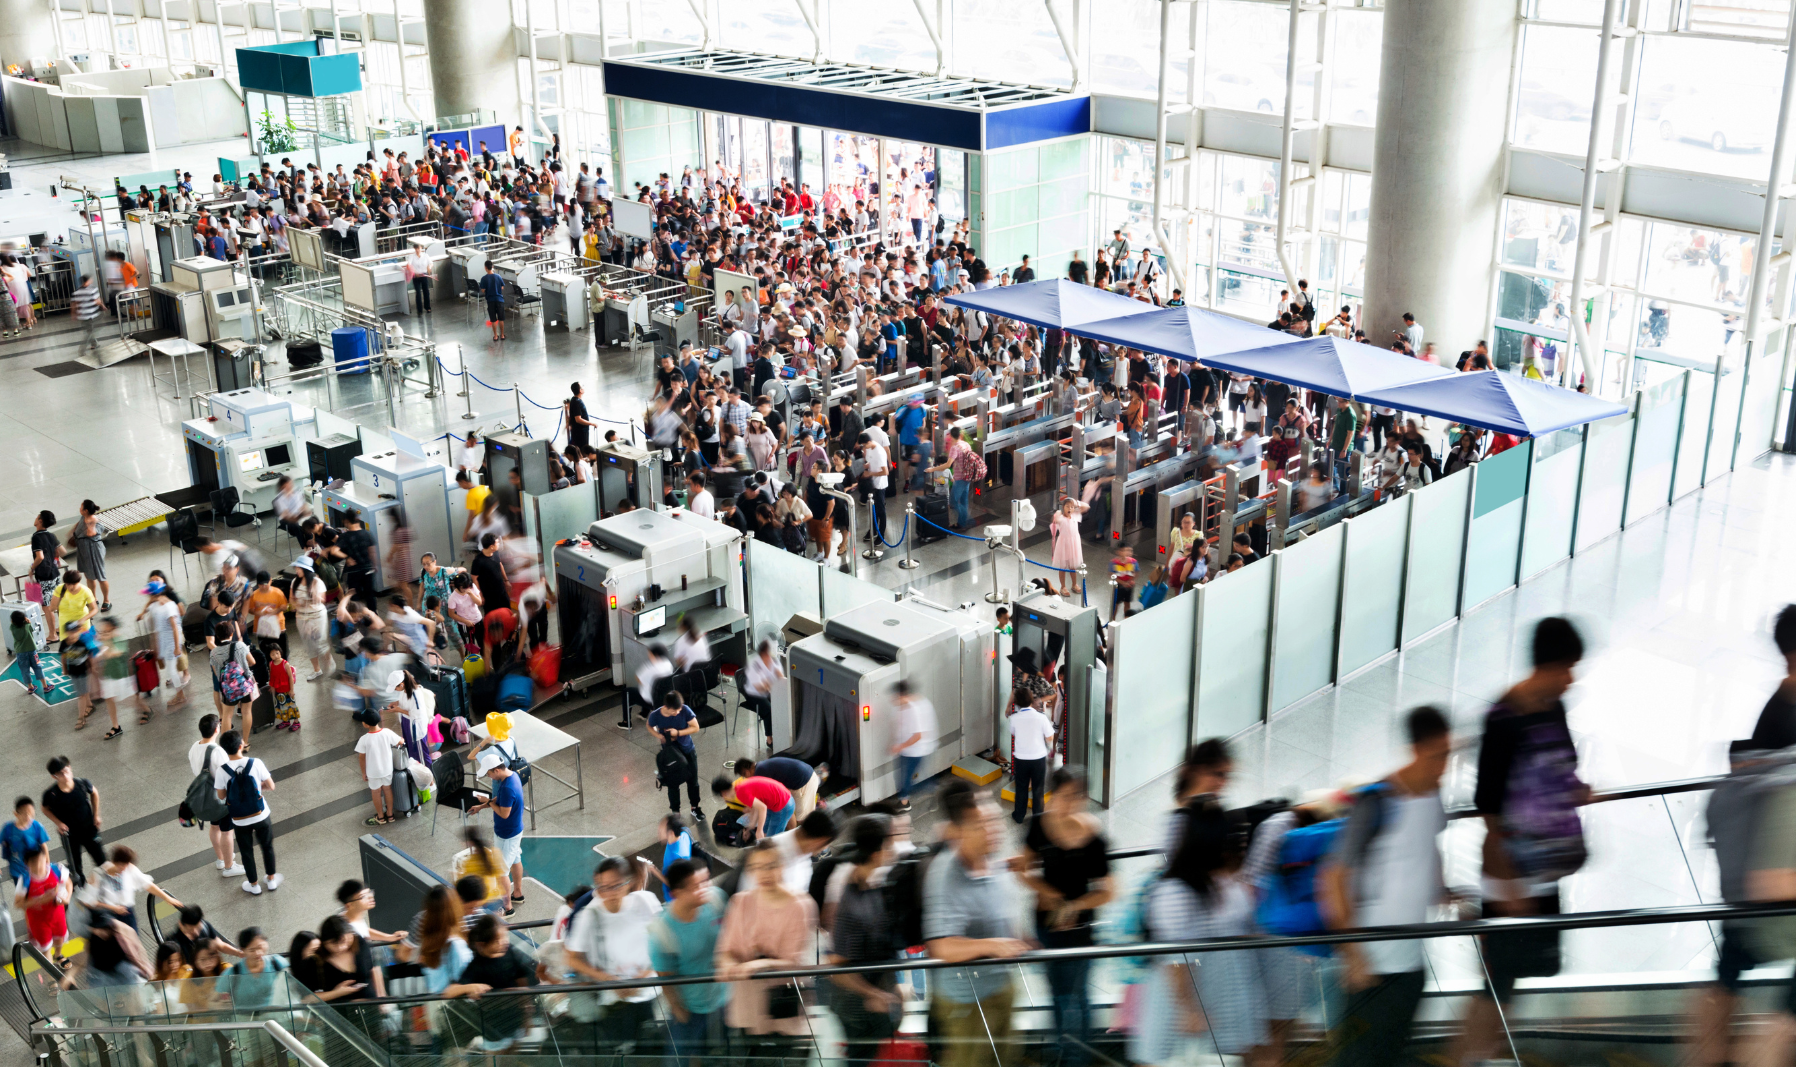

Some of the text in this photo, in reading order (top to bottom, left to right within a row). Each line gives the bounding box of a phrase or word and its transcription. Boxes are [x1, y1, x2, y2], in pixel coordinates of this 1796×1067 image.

[227, 409, 232, 421] 4
[372, 473, 380, 488] 3
[577, 565, 586, 581] 2
[817, 668, 824, 684] 1
